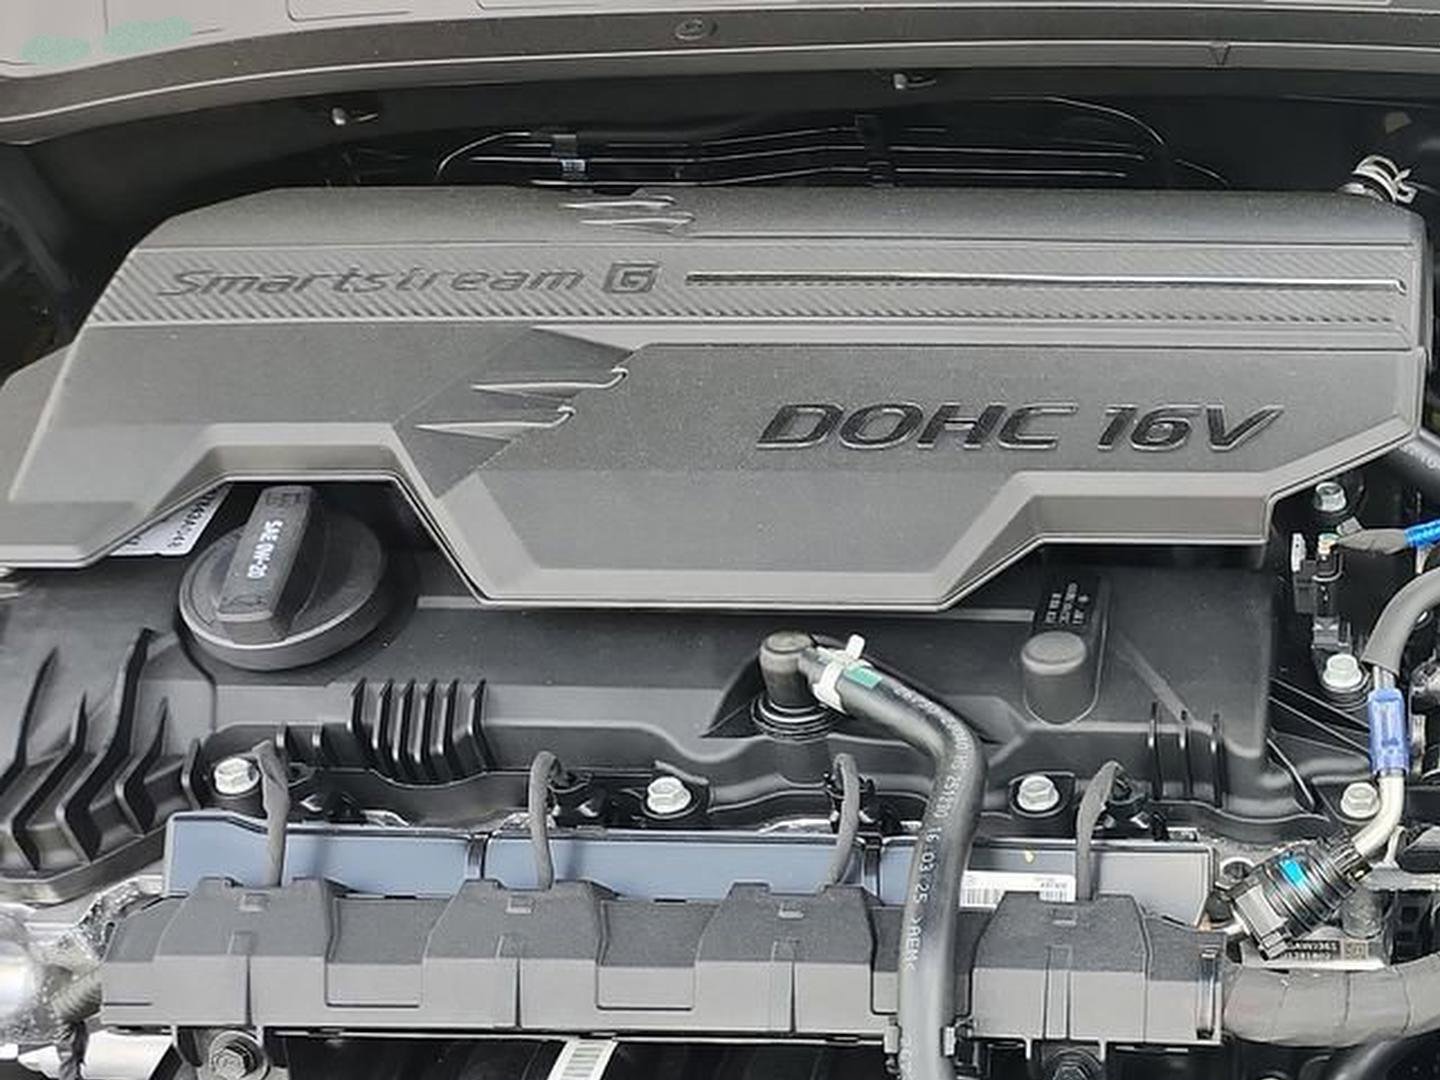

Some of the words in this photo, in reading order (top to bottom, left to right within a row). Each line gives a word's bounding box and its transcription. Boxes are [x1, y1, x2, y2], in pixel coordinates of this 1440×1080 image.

[158, 265, 585, 297] Smartstream
[757, 402, 1079, 451] DOHC
[1096, 402, 1286, 452] 16V
